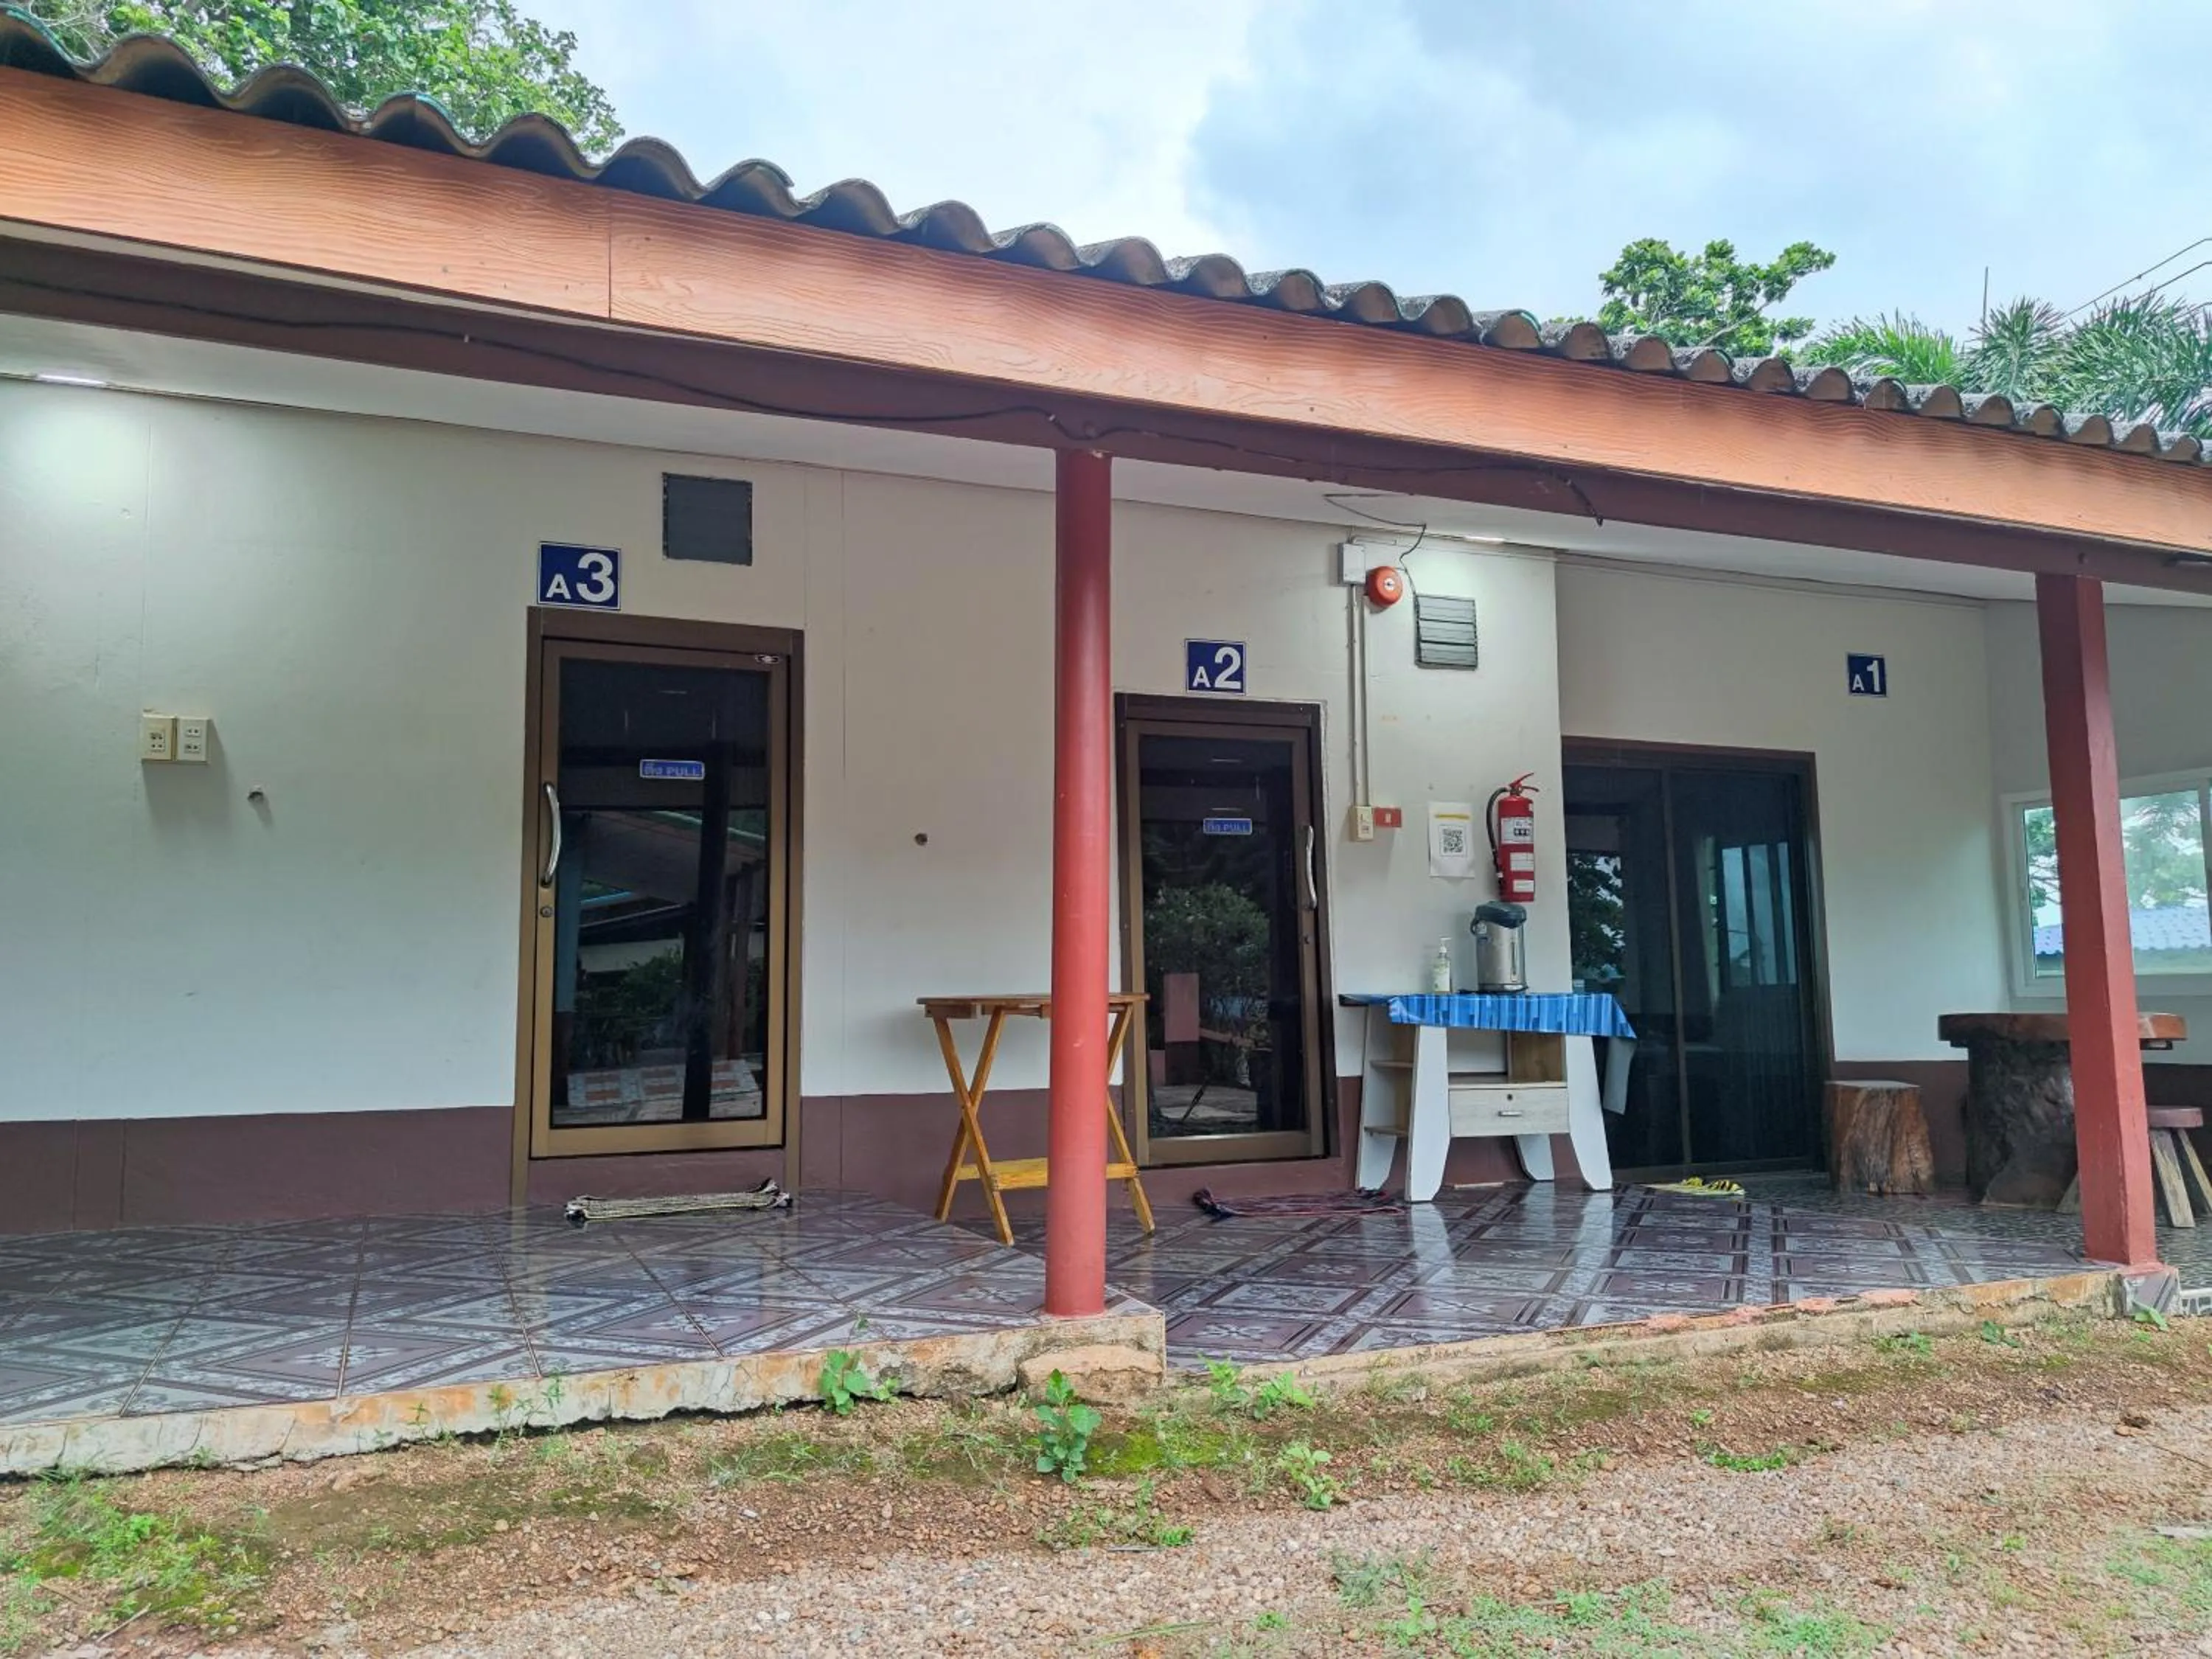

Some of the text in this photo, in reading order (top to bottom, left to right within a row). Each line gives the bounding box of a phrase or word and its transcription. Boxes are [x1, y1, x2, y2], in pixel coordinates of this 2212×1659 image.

[546, 552, 616, 603] A3
[1192, 646, 1242, 689] A2
[1851, 660, 1881, 692] A1
[666, 765, 702, 776] PULL
